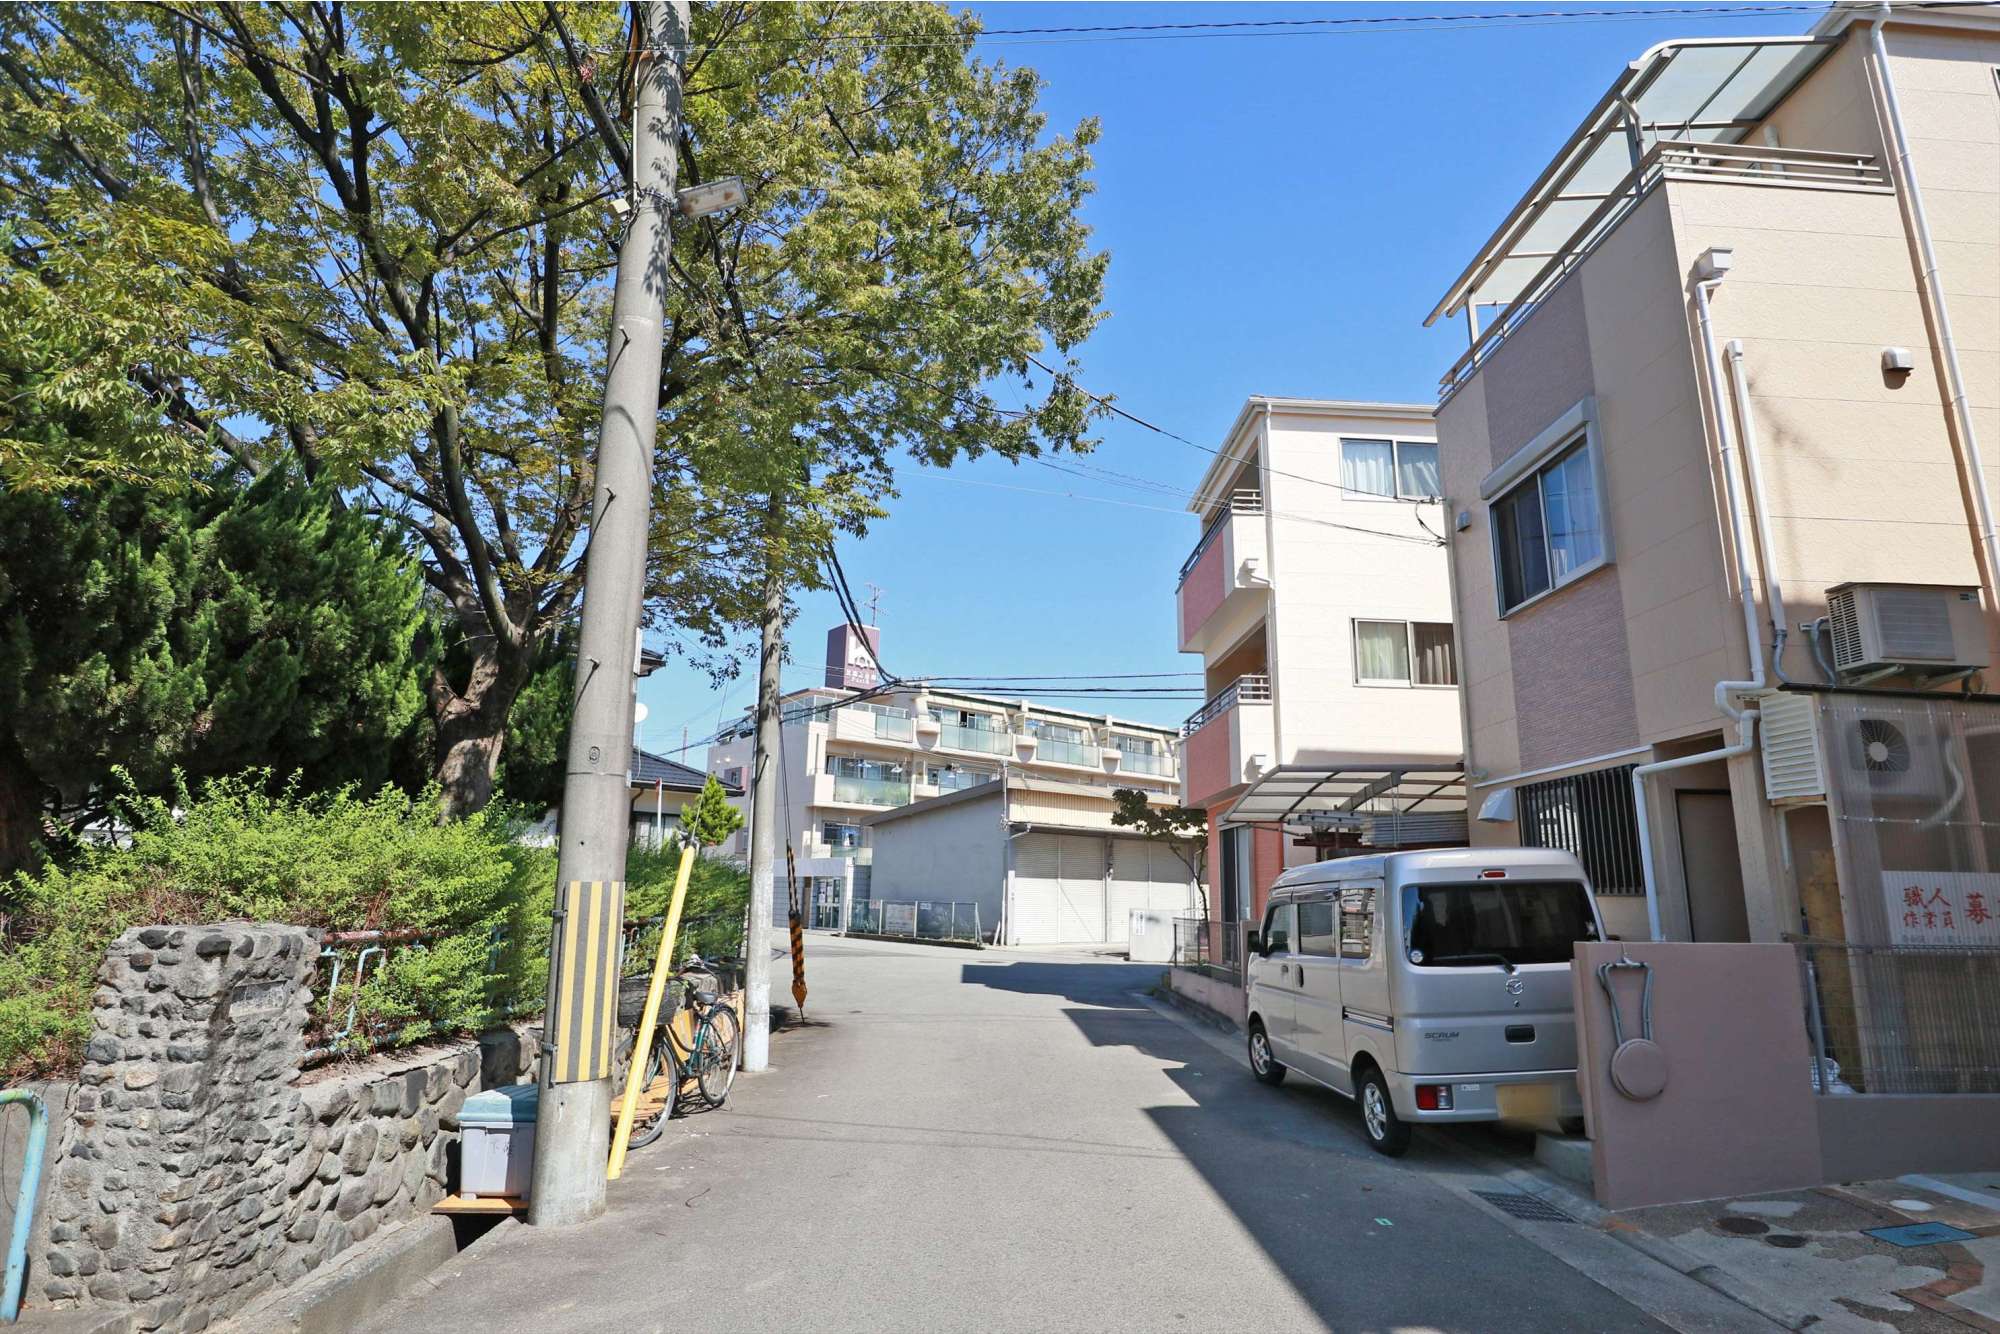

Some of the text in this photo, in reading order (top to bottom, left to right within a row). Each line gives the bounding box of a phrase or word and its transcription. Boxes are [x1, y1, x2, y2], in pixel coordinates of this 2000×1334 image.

[1903, 885, 1952, 908] 職人
[1965, 891, 2000, 925] 募
[1903, 911, 1956, 929] 作業員
[1424, 1031, 1460, 1039] SCRUM
